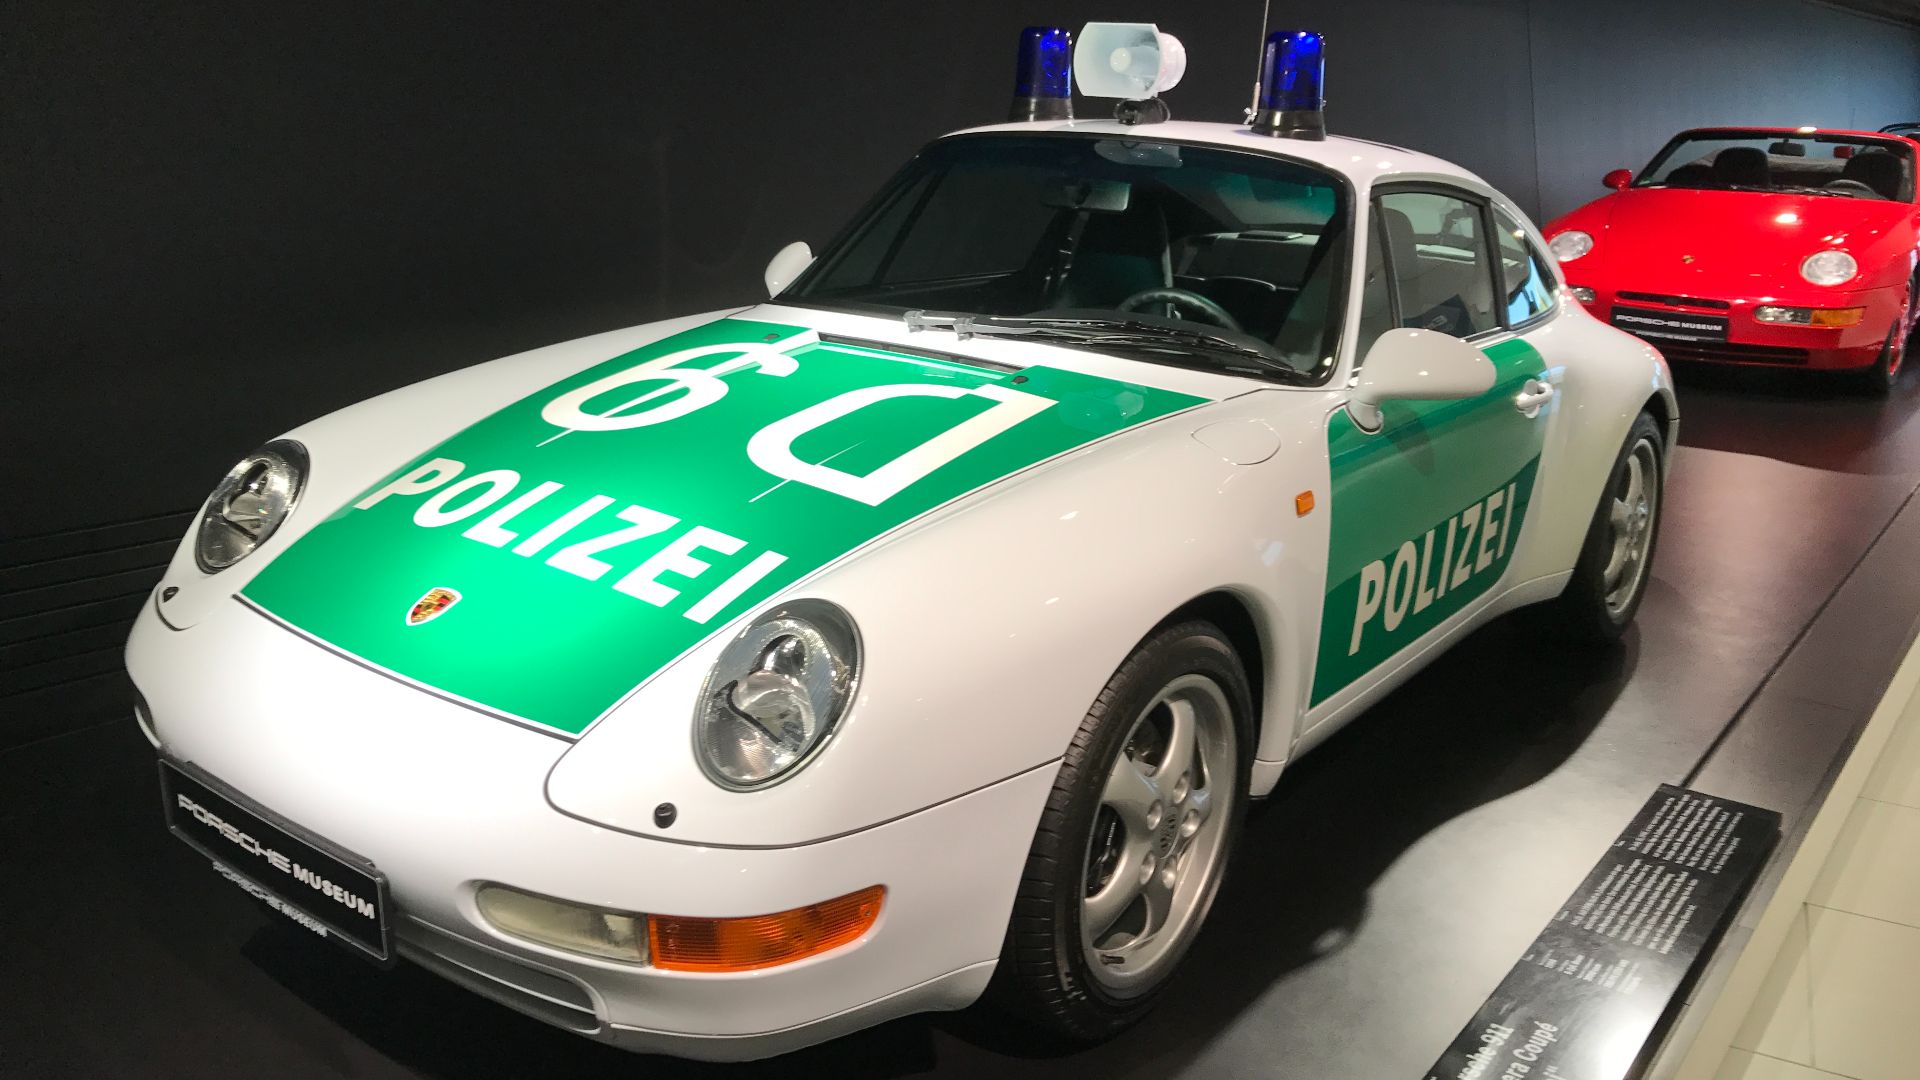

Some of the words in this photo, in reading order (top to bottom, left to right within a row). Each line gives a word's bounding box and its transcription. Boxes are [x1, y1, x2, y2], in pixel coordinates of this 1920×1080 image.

[1615, 314, 1681, 328] PORSCHE
[1681, 321, 1723, 331] MUSEUM
[352, 458, 789, 624] POLIZEI
[1348, 482, 1516, 656] POLIZEI
[177, 793, 292, 874] PORSCHE
[292, 863, 375, 919] MUSEUM
[1480, 1022, 1514, 1047] 911
[1513, 1020, 1559, 1062] Coupé
